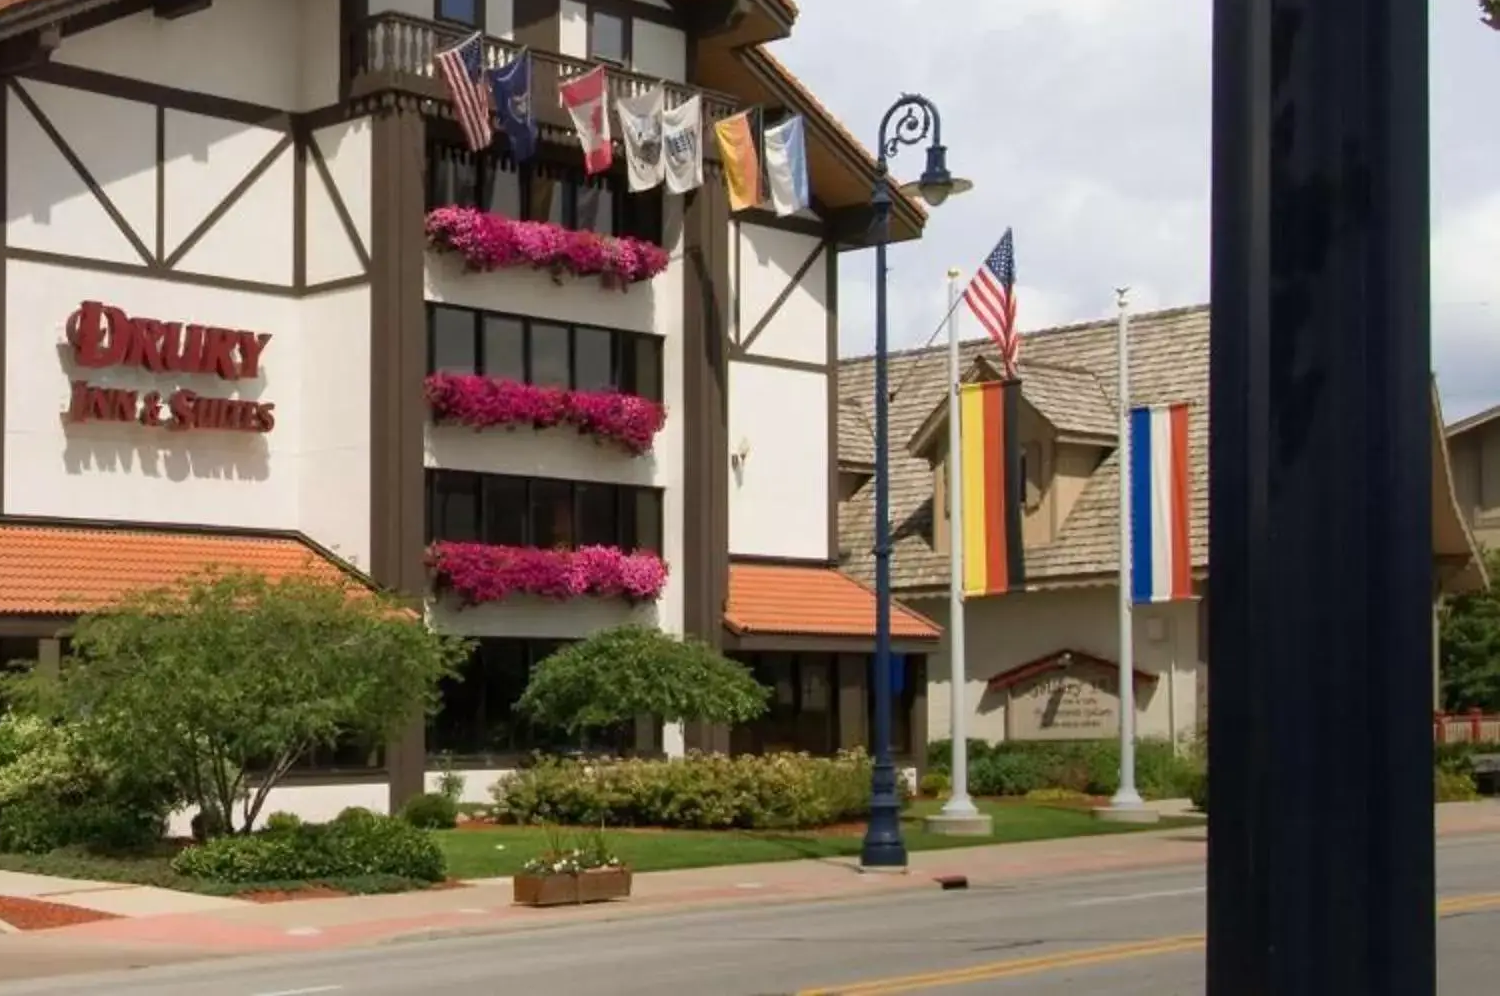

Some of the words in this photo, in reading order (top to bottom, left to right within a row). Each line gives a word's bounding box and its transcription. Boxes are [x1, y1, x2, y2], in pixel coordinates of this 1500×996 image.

[66, 300, 273, 380] DRURY
[71, 381, 138, 423] INN
[140, 390, 162, 427] &
[165, 389, 275, 433] SUITES
